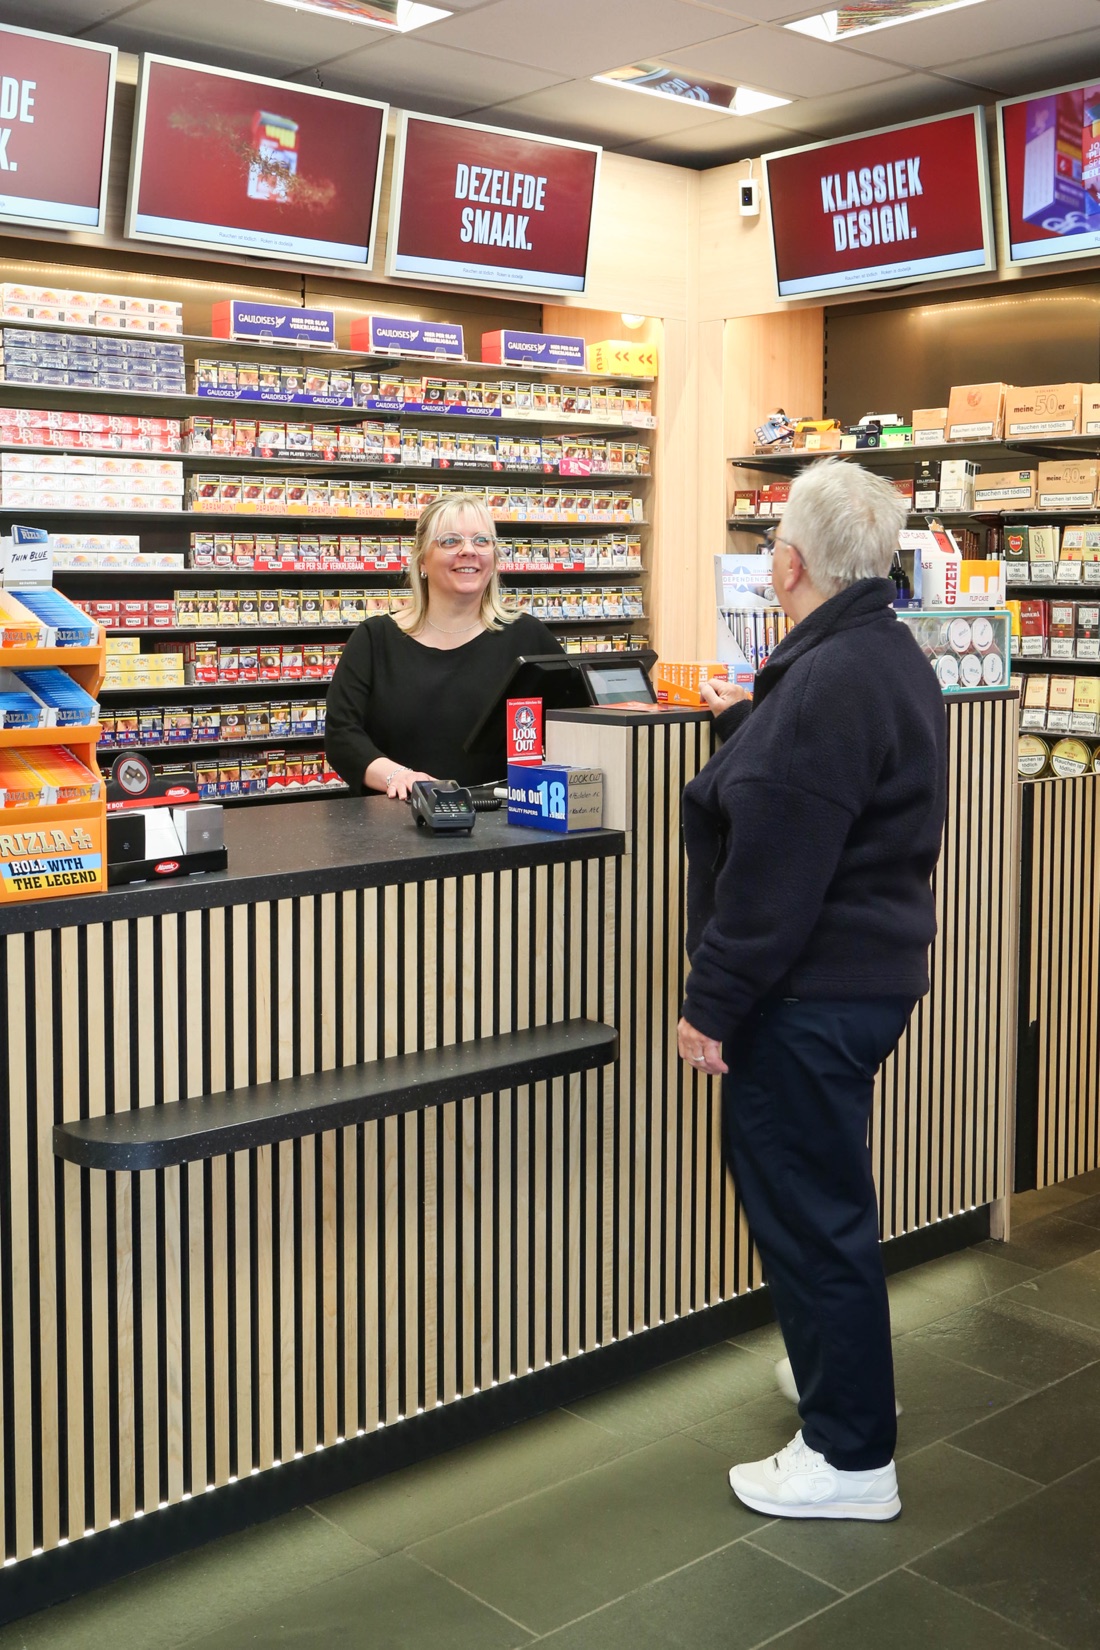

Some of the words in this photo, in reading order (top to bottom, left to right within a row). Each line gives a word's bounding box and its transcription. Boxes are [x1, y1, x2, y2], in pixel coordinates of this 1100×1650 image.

[455, 163, 547, 211] DEZELFDE
[821, 156, 923, 214] KLASSIEK
[460, 207, 532, 250] SMAAK.
[833, 202, 917, 252] DESIGN.
[238, 313, 276, 326] GAULOISES
[376, 329, 410, 339] GAULOISES
[508, 341, 538, 352] GAULOISES
[207, 389, 235, 397] GAULOISES
[261, 393, 288, 401] GAULOISES
[466, 407, 490, 415] GAULOISES
[1014, 405, 1034, 413] meine
[976, 490, 1001, 498] Rauchen
[1010, 487, 1029, 495] tödlich
[202, 503, 236, 512] PARAMOUNT
[256, 505, 288, 513] PARAMOUNT
[307, 506, 340, 515] PARAMOUNT
[355, 508, 386, 517] PARAMOUNT
[11, 553, 28, 563] THIN
[30, 551, 48, 560] BLUE
[294, 562, 306, 570] HIER
[306, 562, 316, 570] PER
[316, 562, 329, 570] SLOF
[329, 562, 364, 570] VERKRIJGBAAR
[945, 562, 958, 605] GIZEH
[513, 728, 537, 740] LOOK
[515, 740, 534, 752] OUT
[1055, 757, 1076, 767] Rauchen
[1059, 765, 1076, 773] tödlich
[569, 774, 589, 784] LOOK
[508, 786, 526, 803] Look
[537, 780, 566, 817] 18
[508, 806, 523, 814] QUALITY
[8, 859, 47, 876] ROLL
[47, 857, 84, 872] WITH
[157, 863, 175, 871] Atomic
[13, 877, 42, 890] THE
[45, 870, 97, 887] LEGEND
